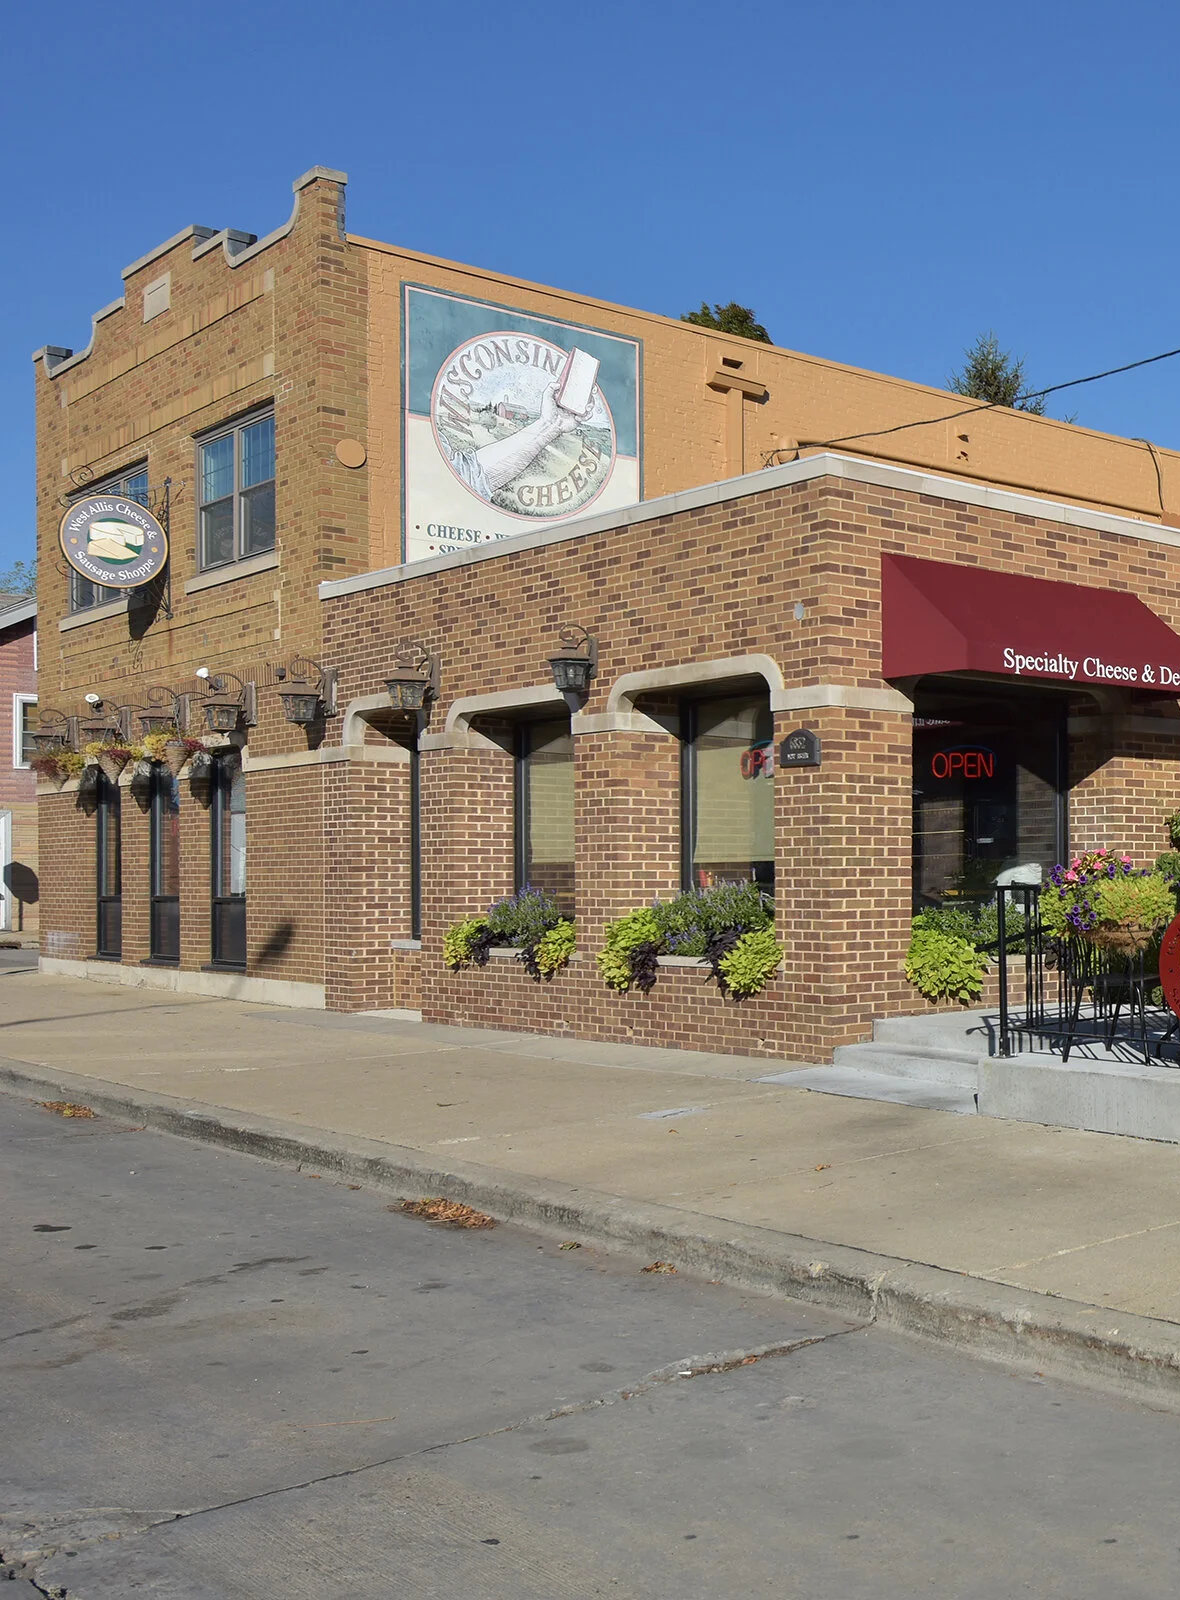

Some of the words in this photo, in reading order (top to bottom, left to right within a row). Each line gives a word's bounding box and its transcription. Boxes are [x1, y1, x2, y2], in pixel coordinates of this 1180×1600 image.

[439, 339, 564, 438] WISCONSIN
[517, 435, 602, 507] CHEESE
[69, 510, 91, 532] West
[88, 502, 114, 515] Allis
[116, 503, 151, 530] Cheese
[146, 530, 158, 540] &
[427, 523, 482, 544] CHEESE
[74, 551, 116, 580] Sausage
[118, 558, 155, 581] Shoppe
[1003, 647, 1079, 680] Specialty
[1083, 657, 1138, 682] Cheese
[1141, 664, 1156, 683] &
[932, 752, 993, 778] OPEN
